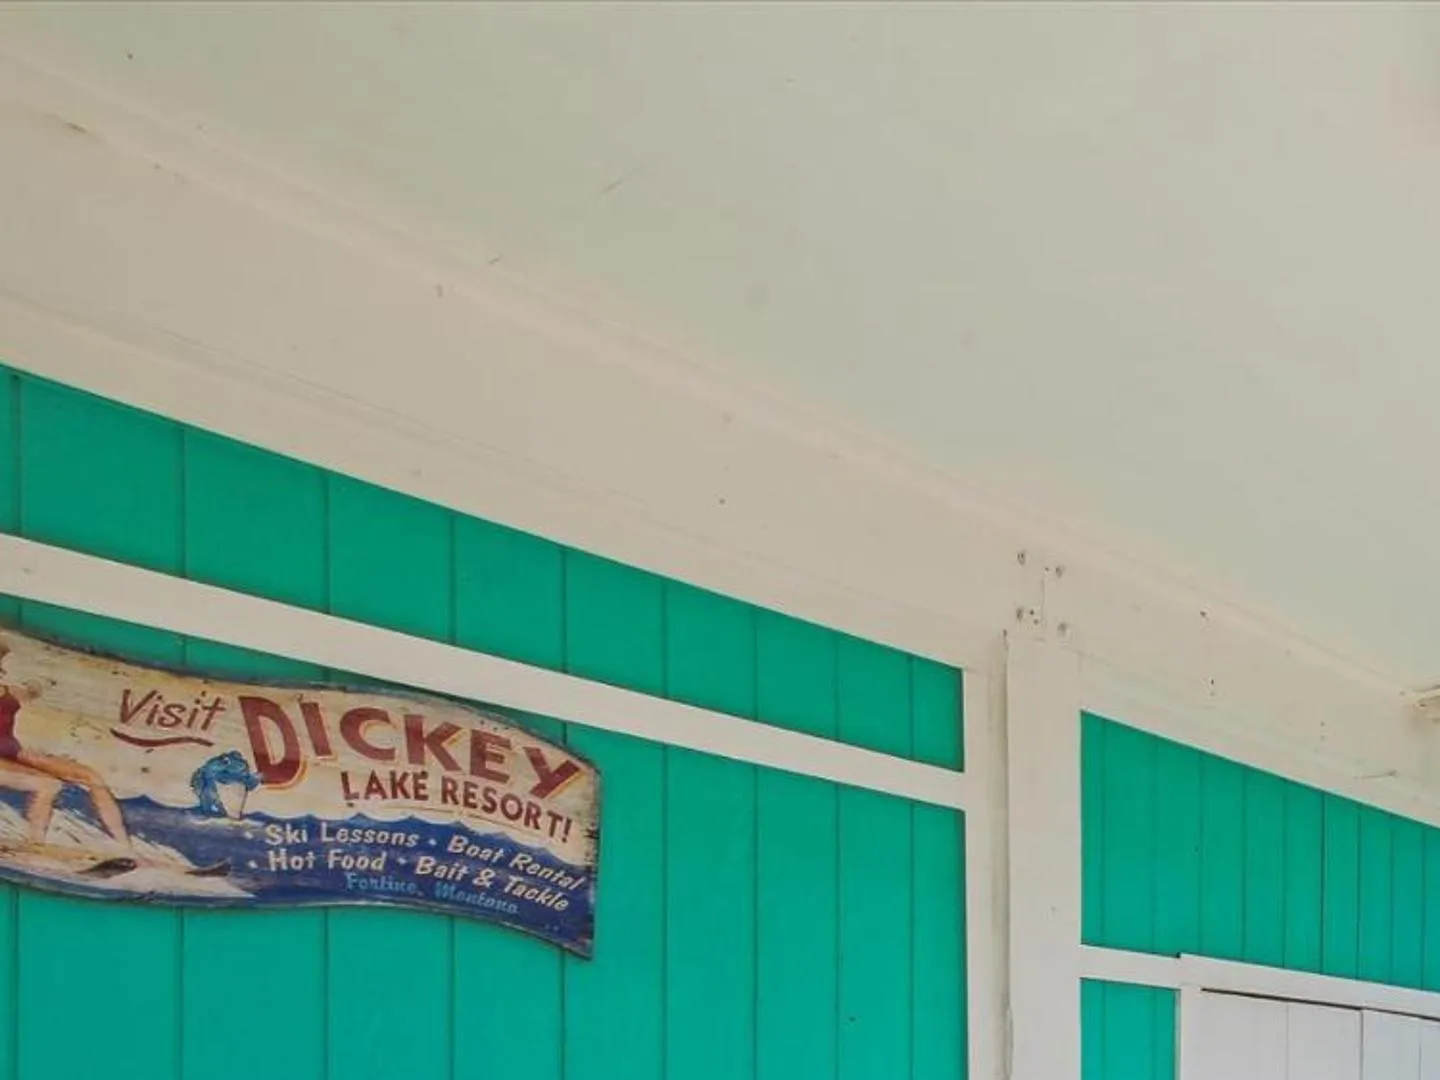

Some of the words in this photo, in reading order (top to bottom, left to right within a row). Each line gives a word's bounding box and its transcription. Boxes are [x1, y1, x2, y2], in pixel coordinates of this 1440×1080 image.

[118, 689, 226, 731] Visit
[238, 695, 584, 800] DICKEY
[341, 770, 429, 801] LAKE
[441, 776, 573, 843] RESORT!
[265, 822, 308, 846] Ski
[320, 821, 420, 848] Lessons
[447, 834, 505, 864] Boat
[509, 852, 586, 890] Rental
[268, 849, 316, 872] Hot
[328, 849, 387, 871] Food
[415, 855, 469, 881] Bait
[472, 867, 496, 888] &
[503, 874, 569, 911] Tackle
[433, 881, 519, 915] Montana
